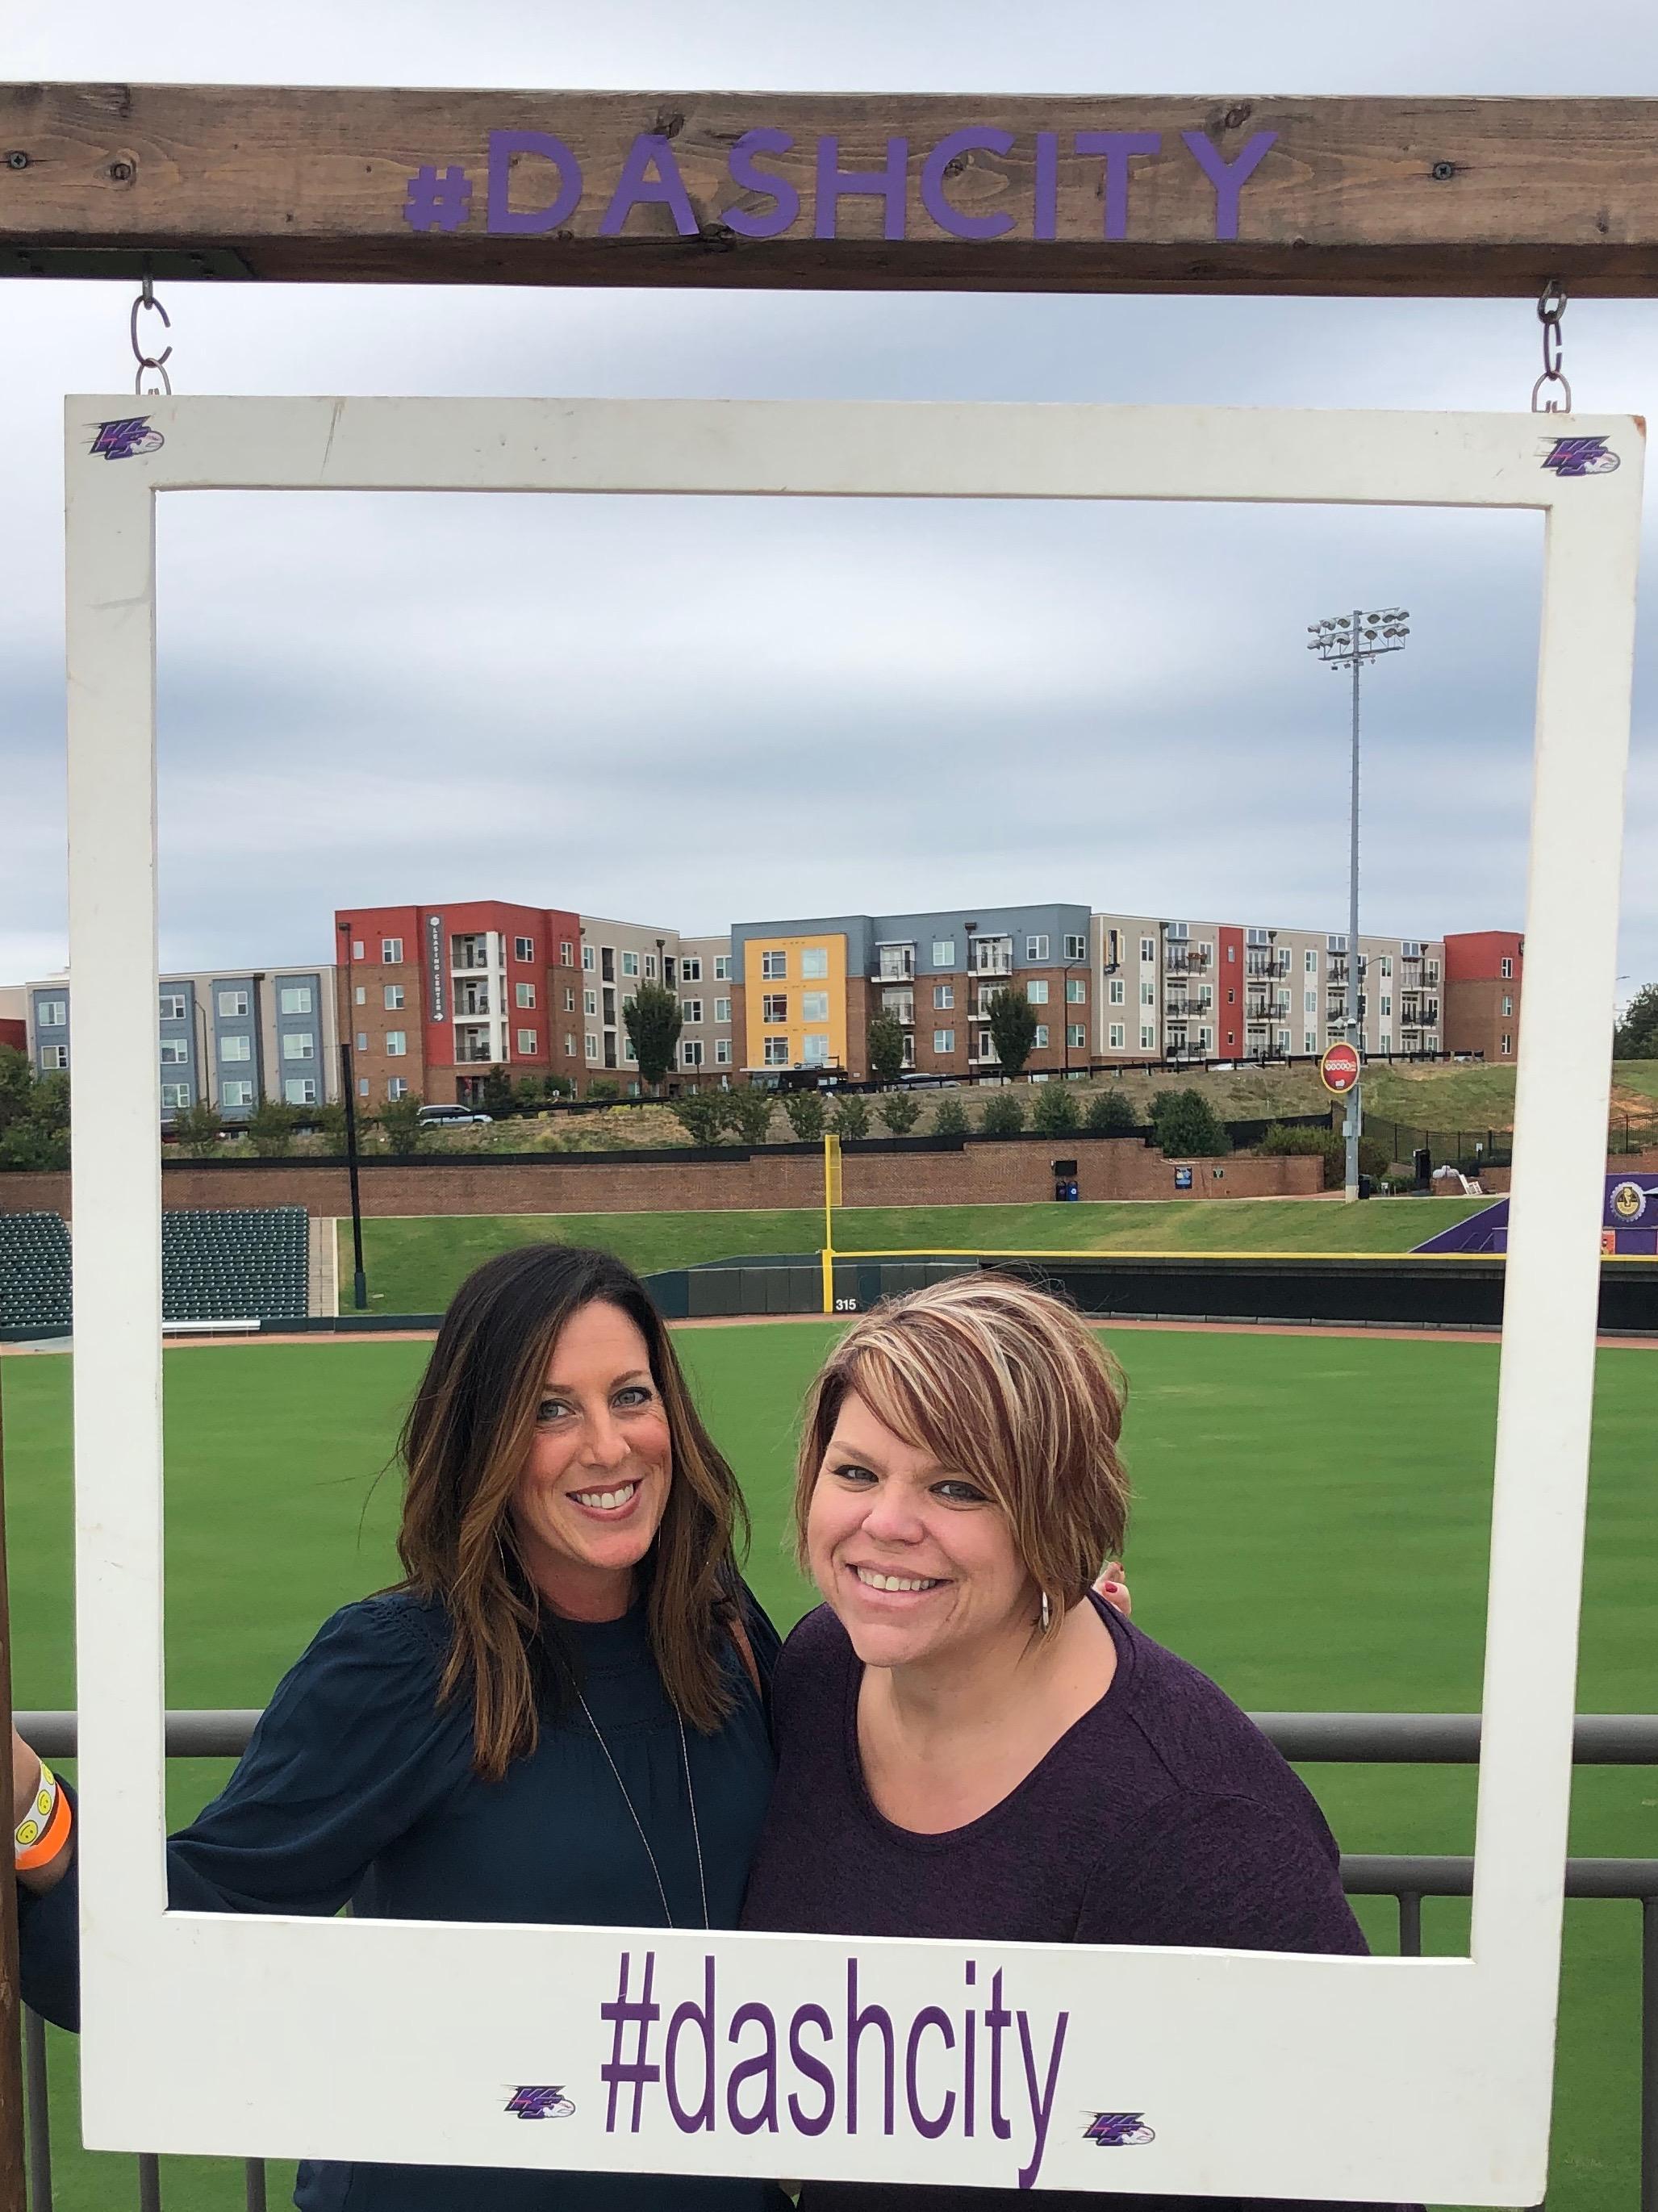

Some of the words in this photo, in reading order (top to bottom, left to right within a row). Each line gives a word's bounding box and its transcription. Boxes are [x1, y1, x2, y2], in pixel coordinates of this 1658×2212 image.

[403, 126, 1279, 241] #DASHCITY
[432, 927, 441, 970] LEASING
[835, 1298, 857, 1311] 315
[601, 1951, 1070, 2190] #dashcity
